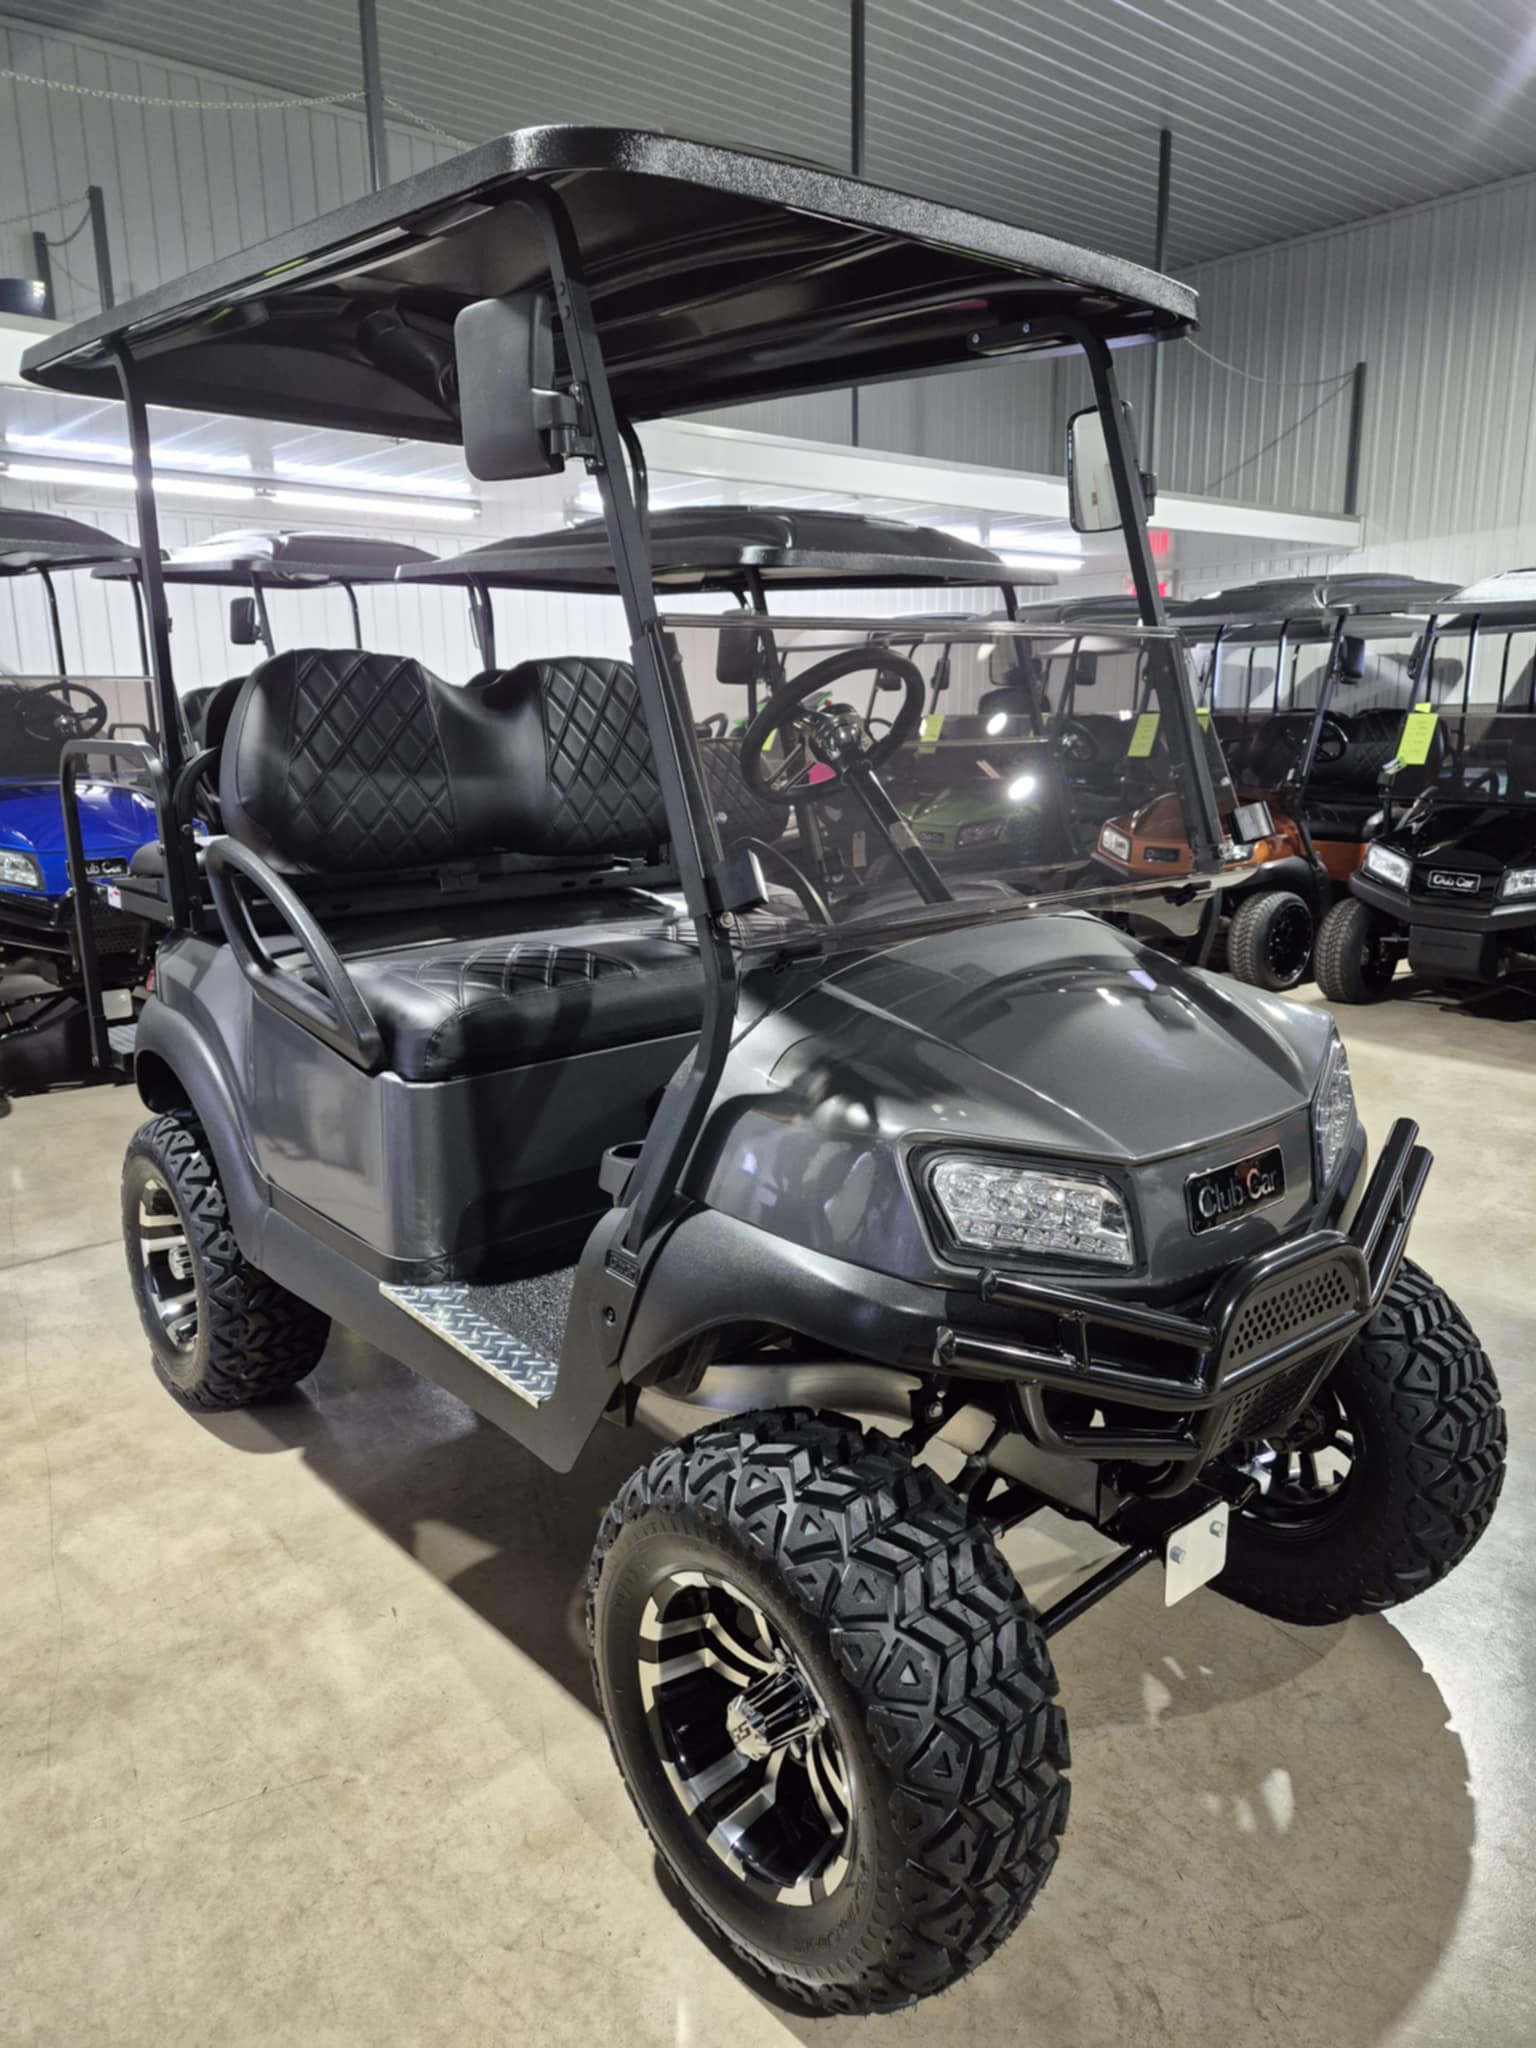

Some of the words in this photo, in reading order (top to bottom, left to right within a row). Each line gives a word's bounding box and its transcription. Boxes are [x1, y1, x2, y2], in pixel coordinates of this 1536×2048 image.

[1455, 876, 1475, 888] Car
[1198, 1178, 1245, 1218] Club
[1246, 1167, 1277, 1200] Car
